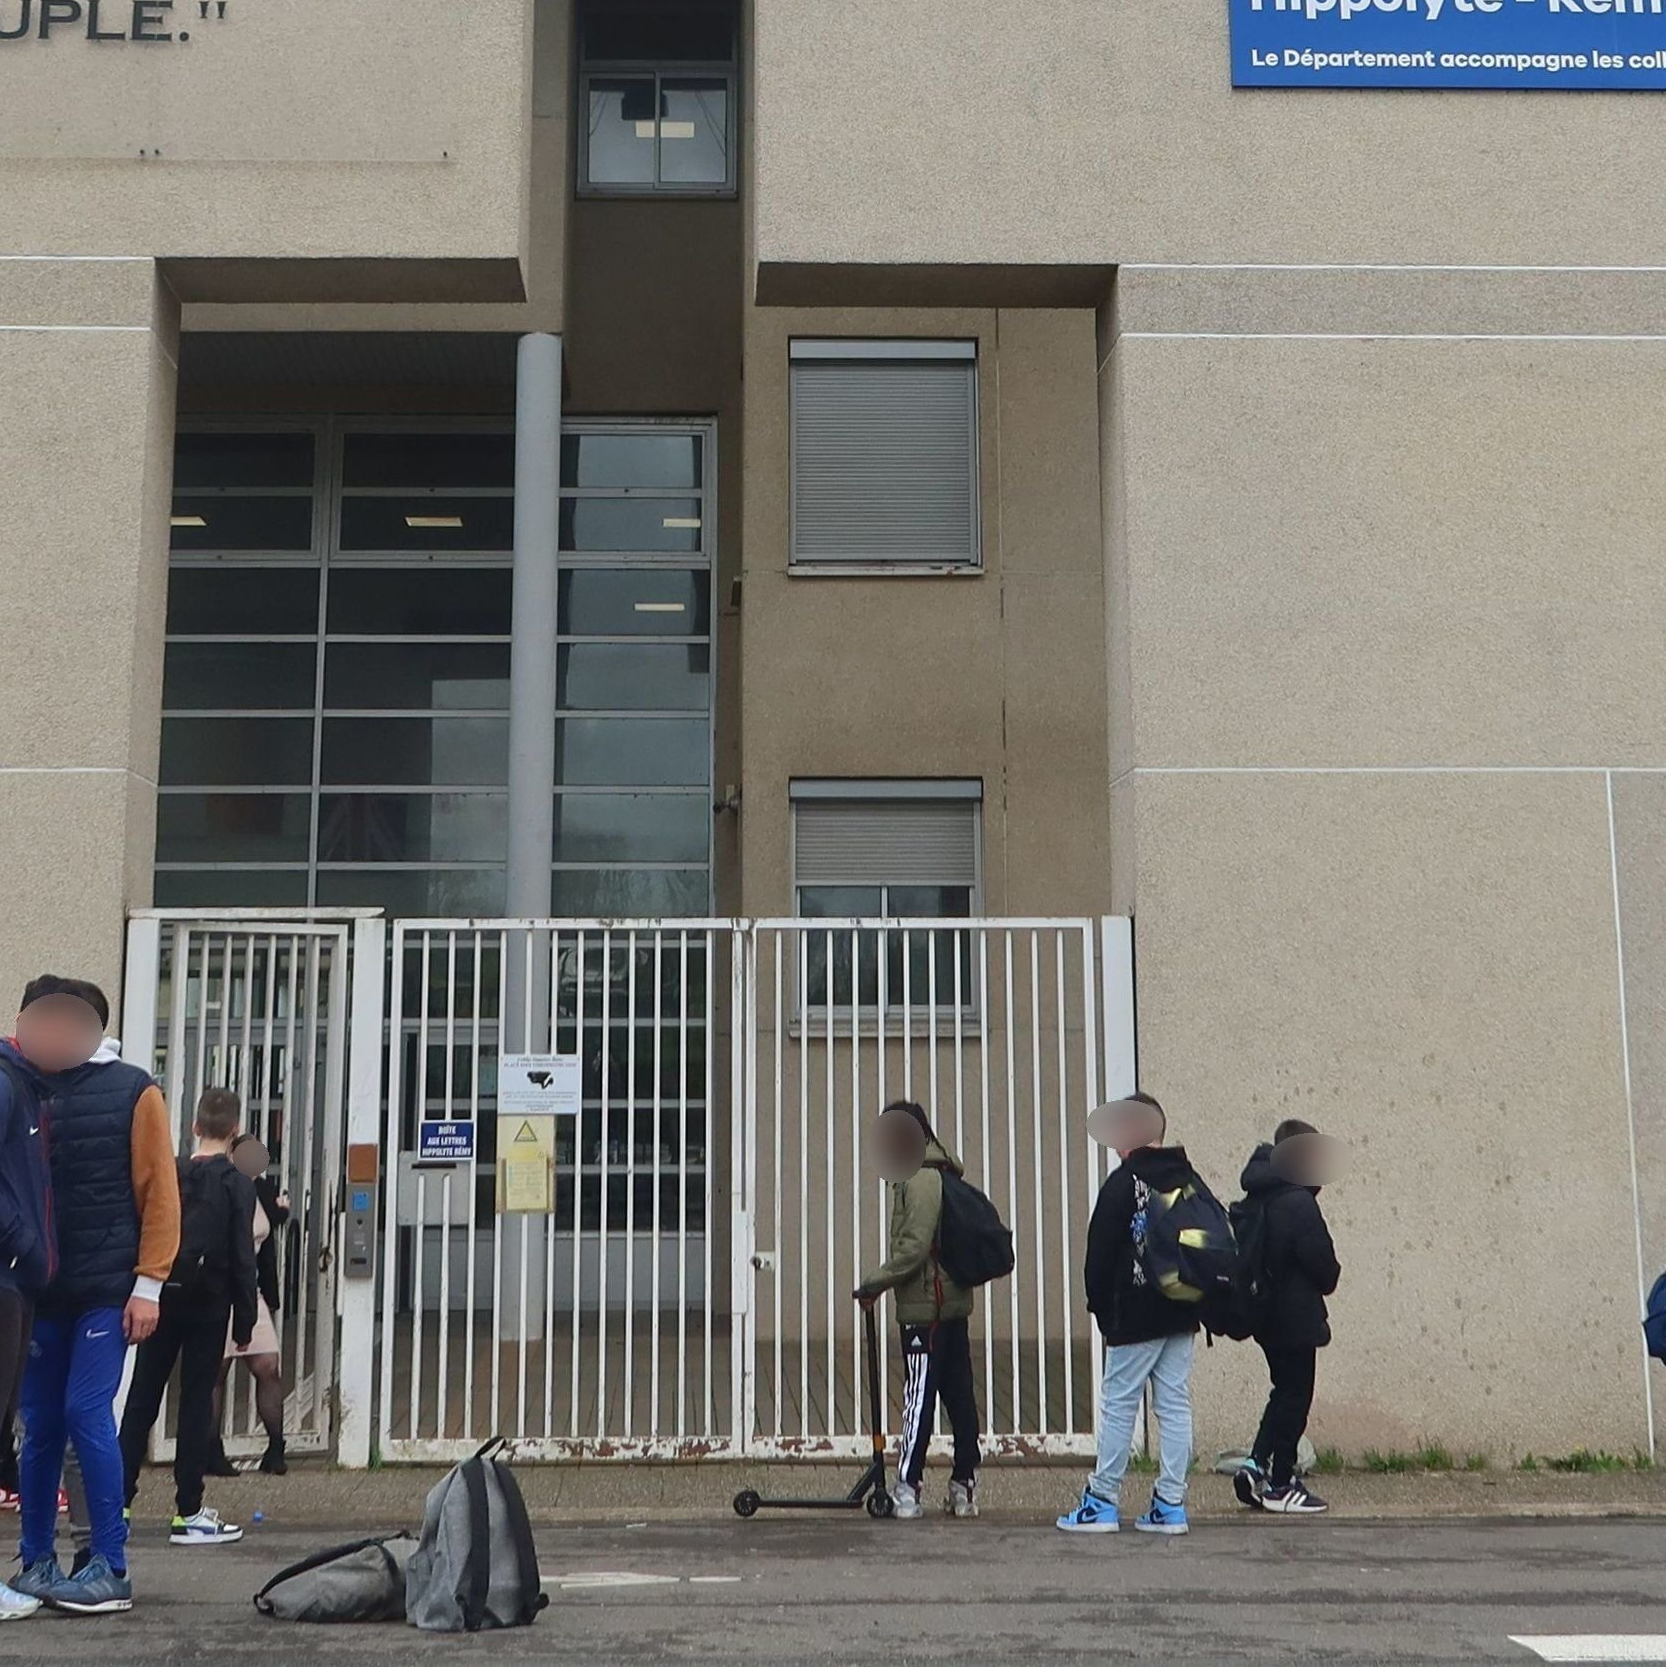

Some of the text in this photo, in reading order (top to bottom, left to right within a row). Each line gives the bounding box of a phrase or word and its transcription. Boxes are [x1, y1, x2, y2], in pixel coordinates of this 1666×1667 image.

[1250, 49, 1279, 68] Le
[1284, 47, 1436, 71] Département
[1440, 52, 1588, 72] accompagne
[1592, 50, 1625, 70] les
[427, 1136, 467, 1146] AUX LETTRES
[422, 1145, 472, 1157] HIPPOLYTE RÉMY
